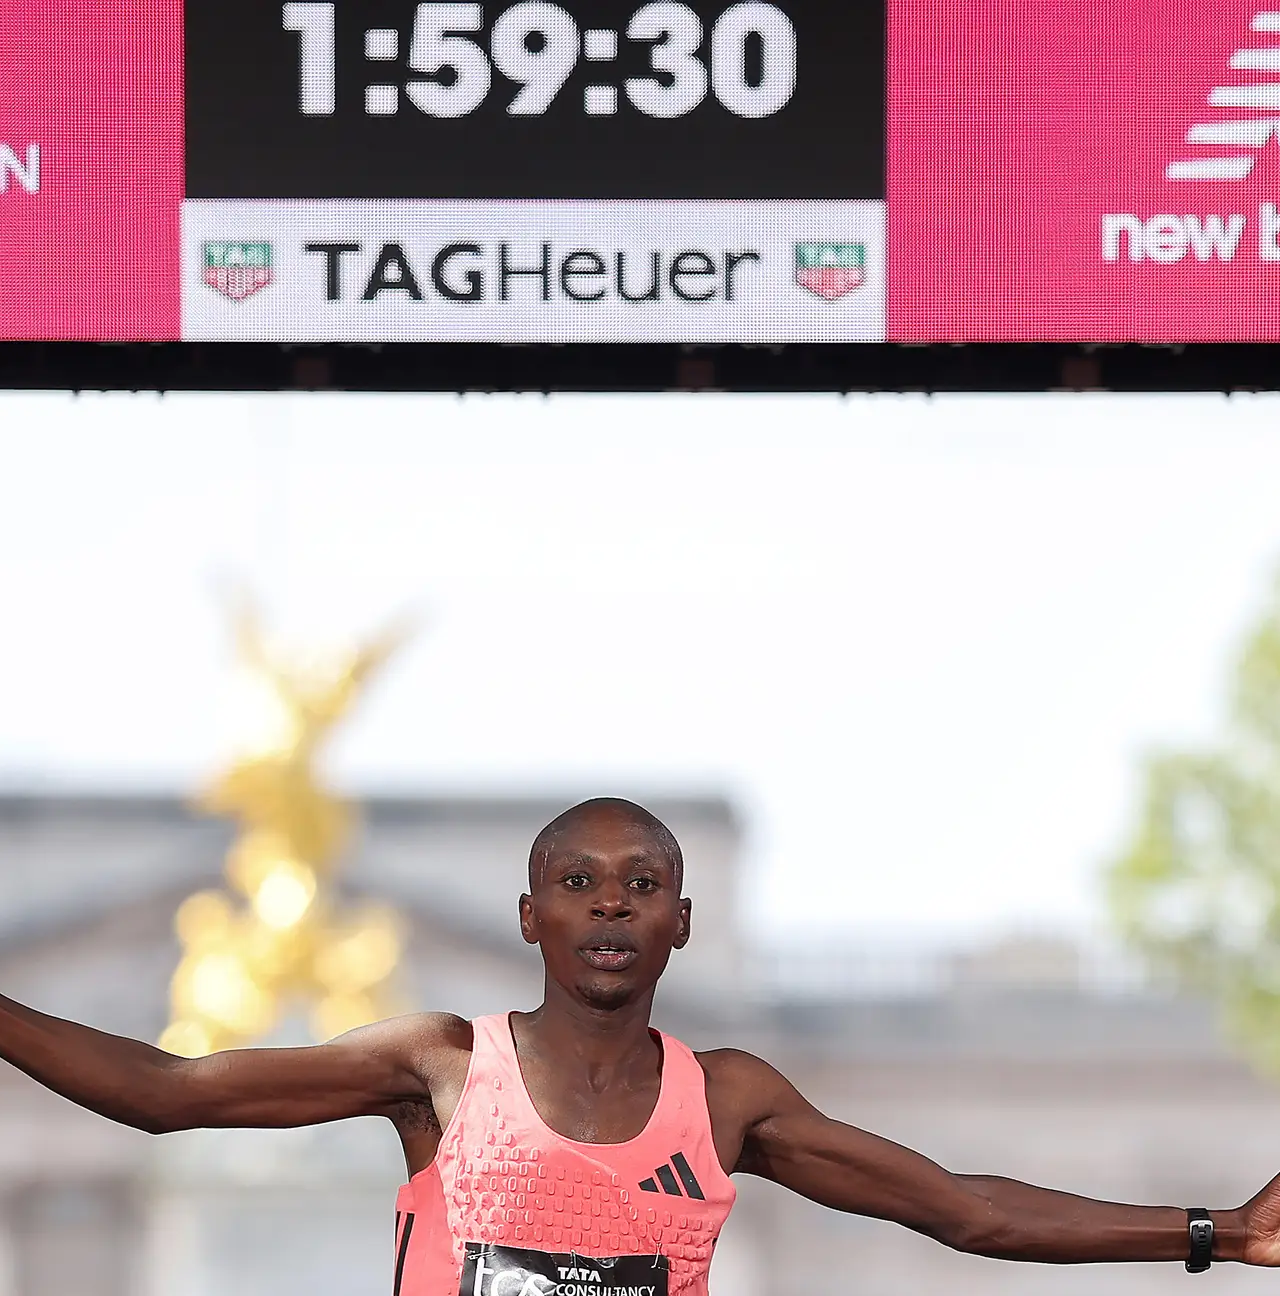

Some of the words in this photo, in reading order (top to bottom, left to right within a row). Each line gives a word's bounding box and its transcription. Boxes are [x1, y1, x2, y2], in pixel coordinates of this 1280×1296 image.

[282, 0, 797, 119] 1:59:30
[1101, 213, 1246, 264] new
[557, 1266, 602, 1283] TATA
